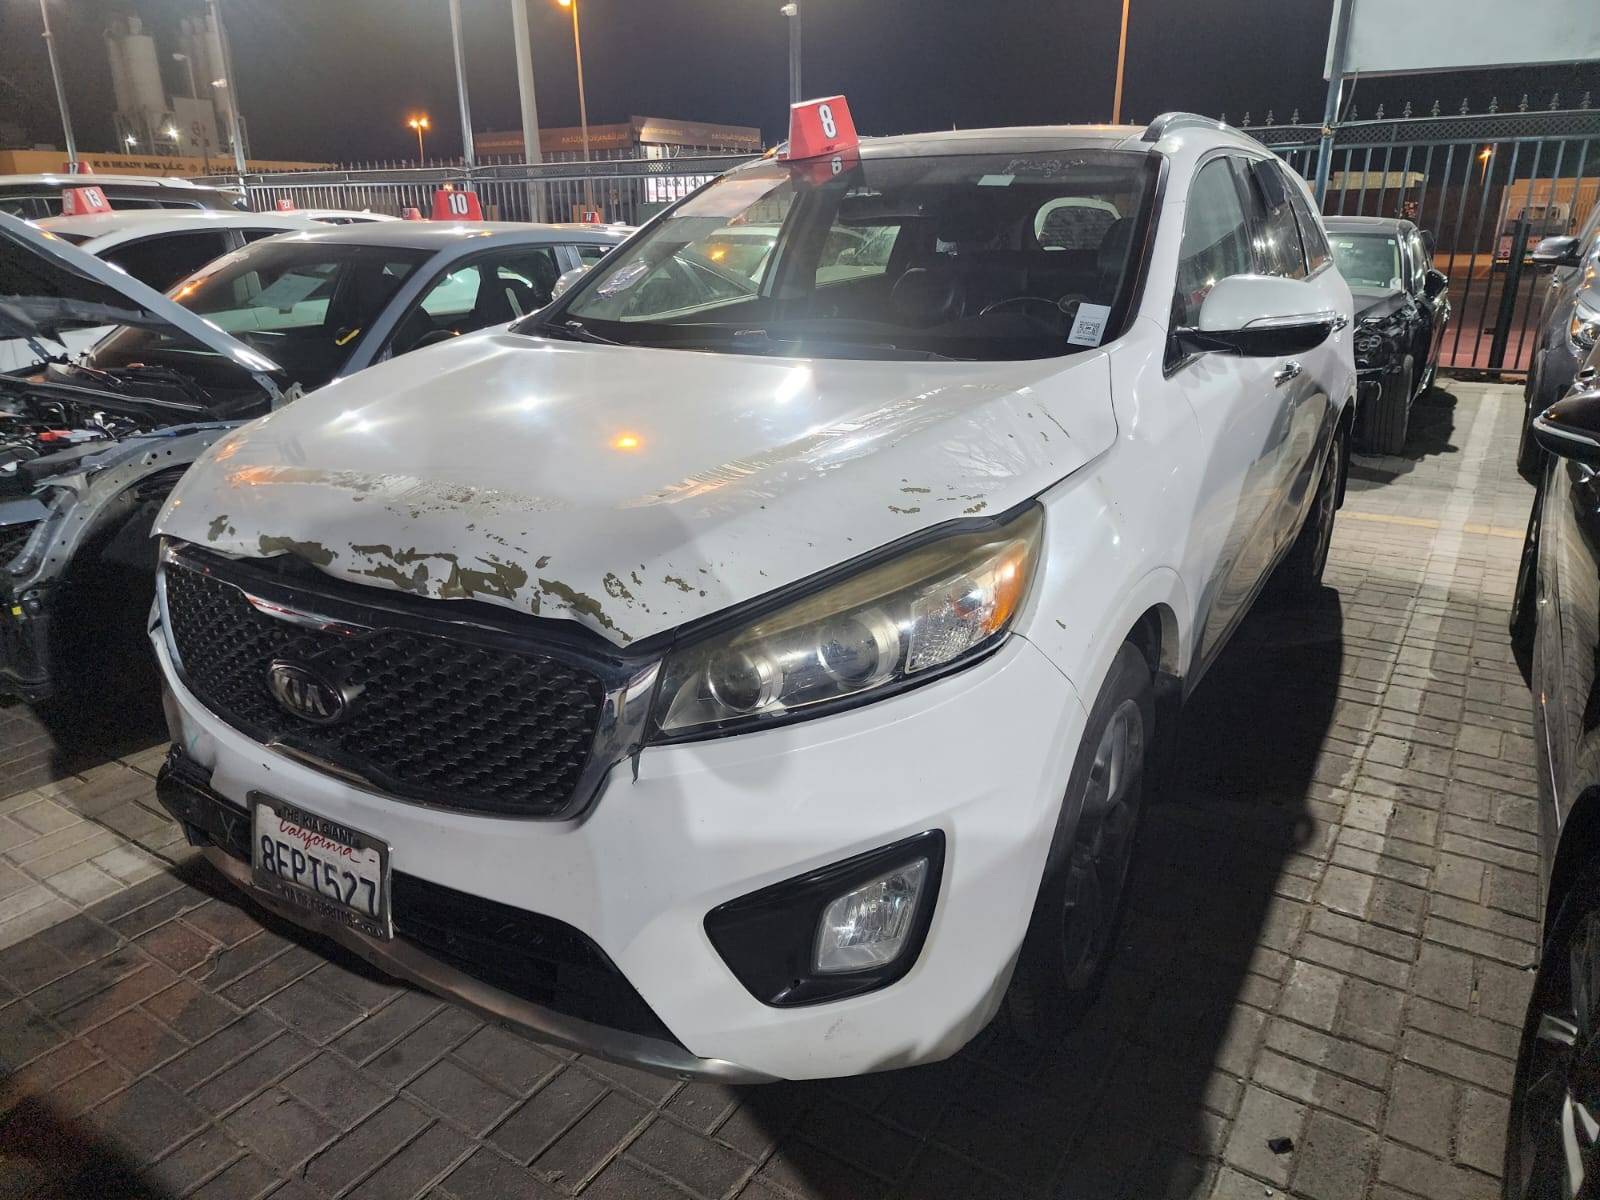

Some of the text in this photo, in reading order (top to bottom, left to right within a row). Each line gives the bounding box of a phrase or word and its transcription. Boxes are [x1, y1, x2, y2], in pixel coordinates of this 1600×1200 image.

[819, 104, 837, 138] 8
[85, 189, 104, 208] 13
[448, 193, 468, 215] 10
[280, 818, 361, 864] California
